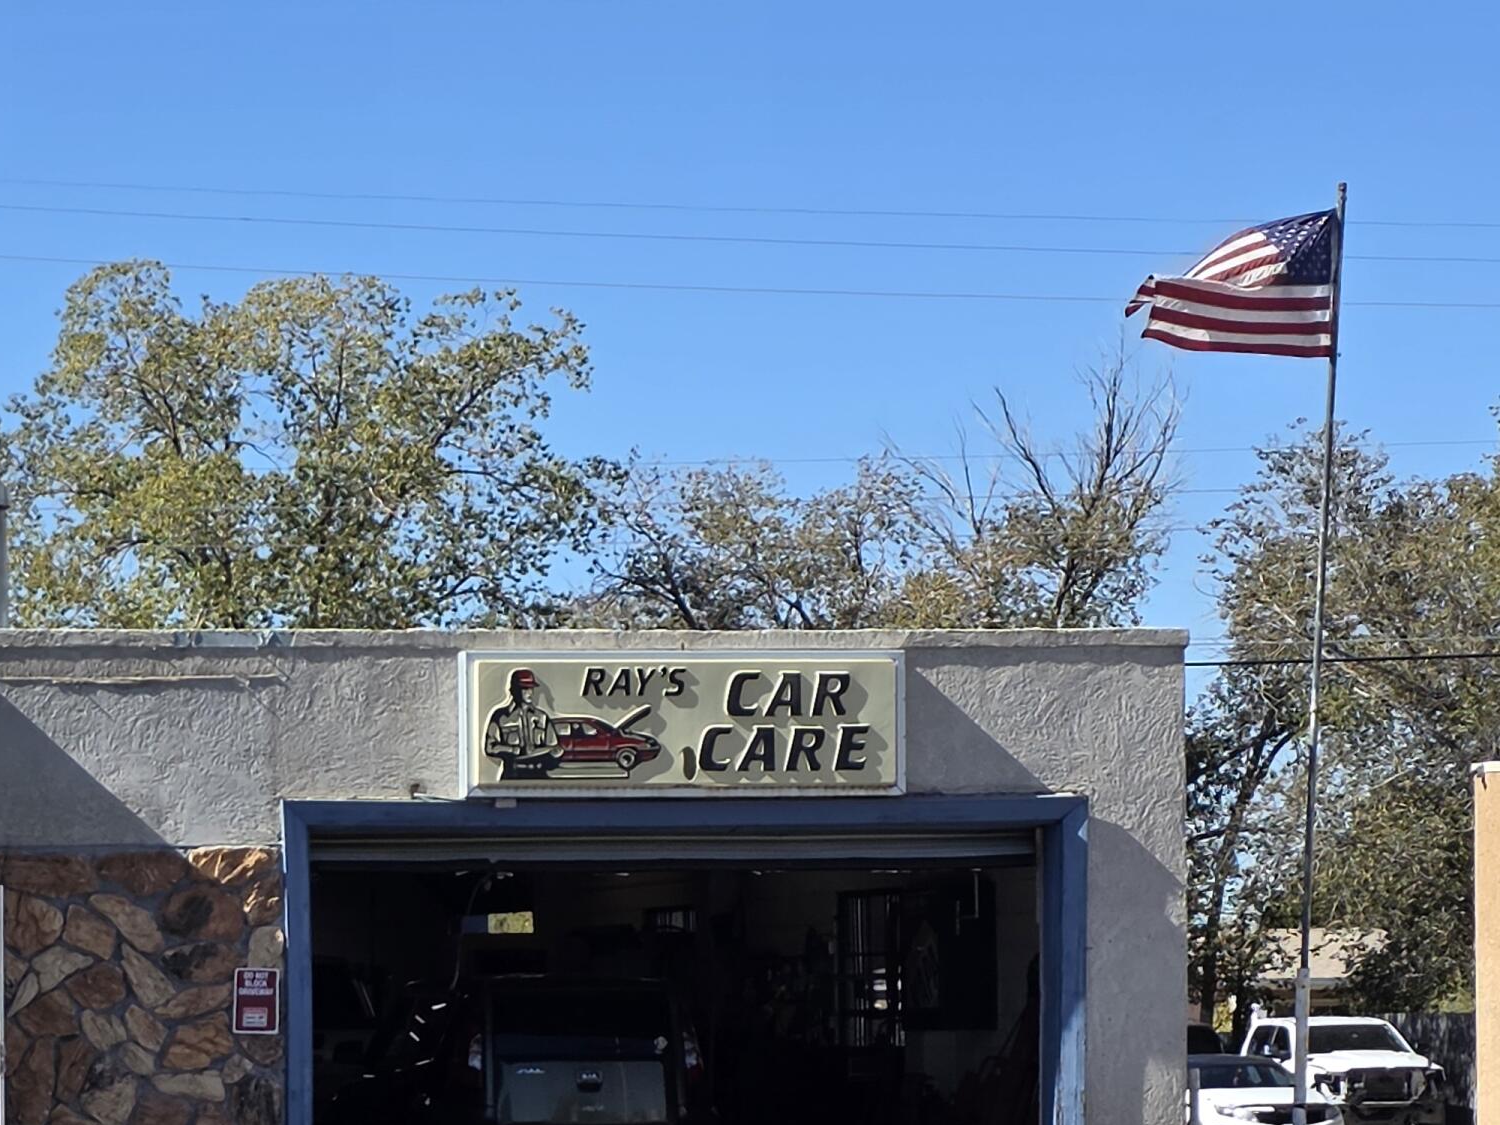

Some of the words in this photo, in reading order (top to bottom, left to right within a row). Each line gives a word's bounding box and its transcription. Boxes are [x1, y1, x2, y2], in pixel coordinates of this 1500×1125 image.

[581, 667, 687, 697] RAY'S
[725, 670, 851, 718] CAR
[698, 725, 871, 772] CARE
